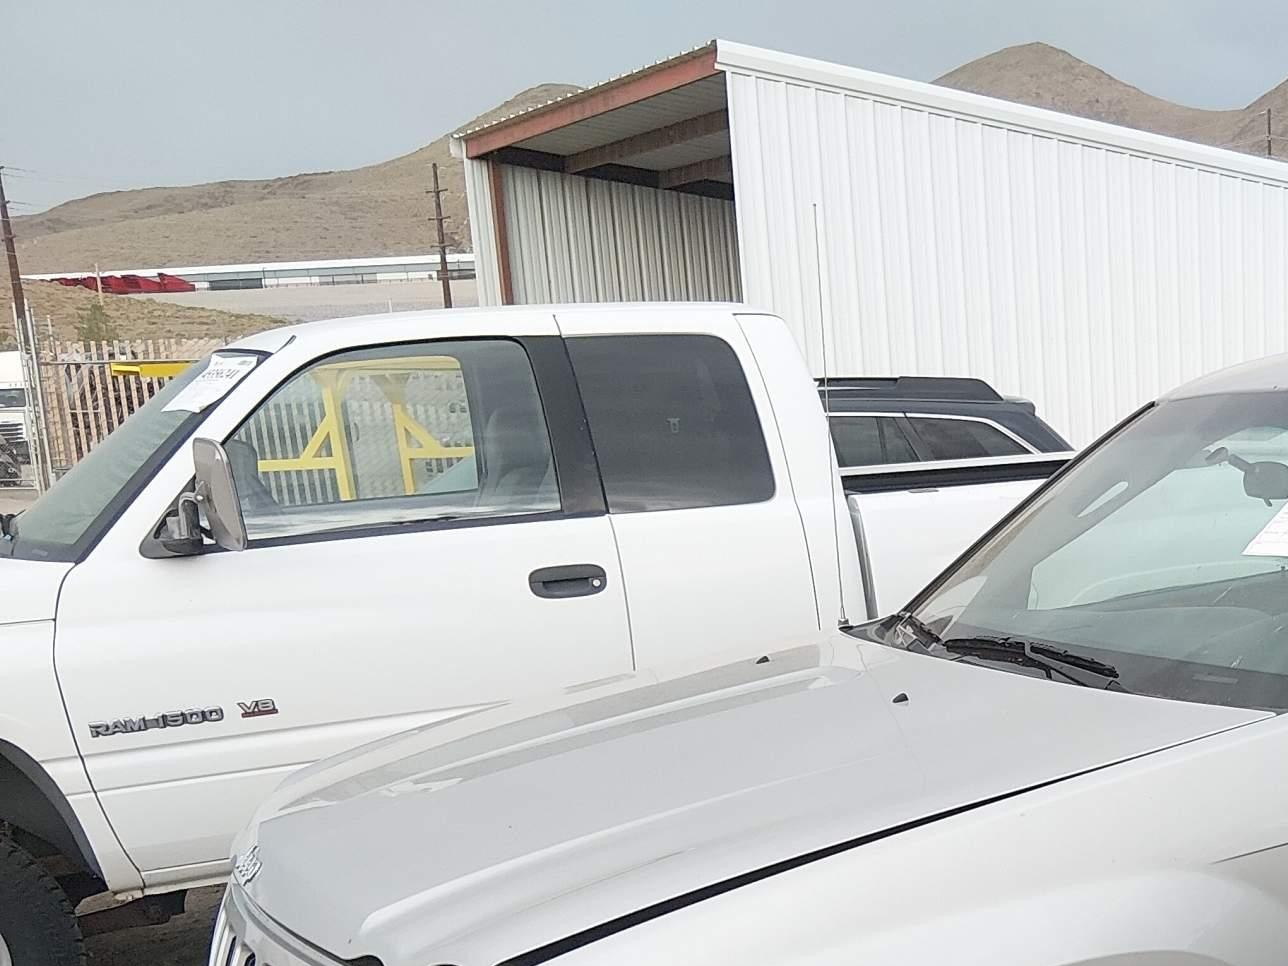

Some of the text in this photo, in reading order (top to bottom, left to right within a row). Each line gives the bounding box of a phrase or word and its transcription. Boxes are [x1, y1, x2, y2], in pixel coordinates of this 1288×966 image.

[237, 698, 277, 716] V8
[88, 705, 225, 739] RAM 1500
